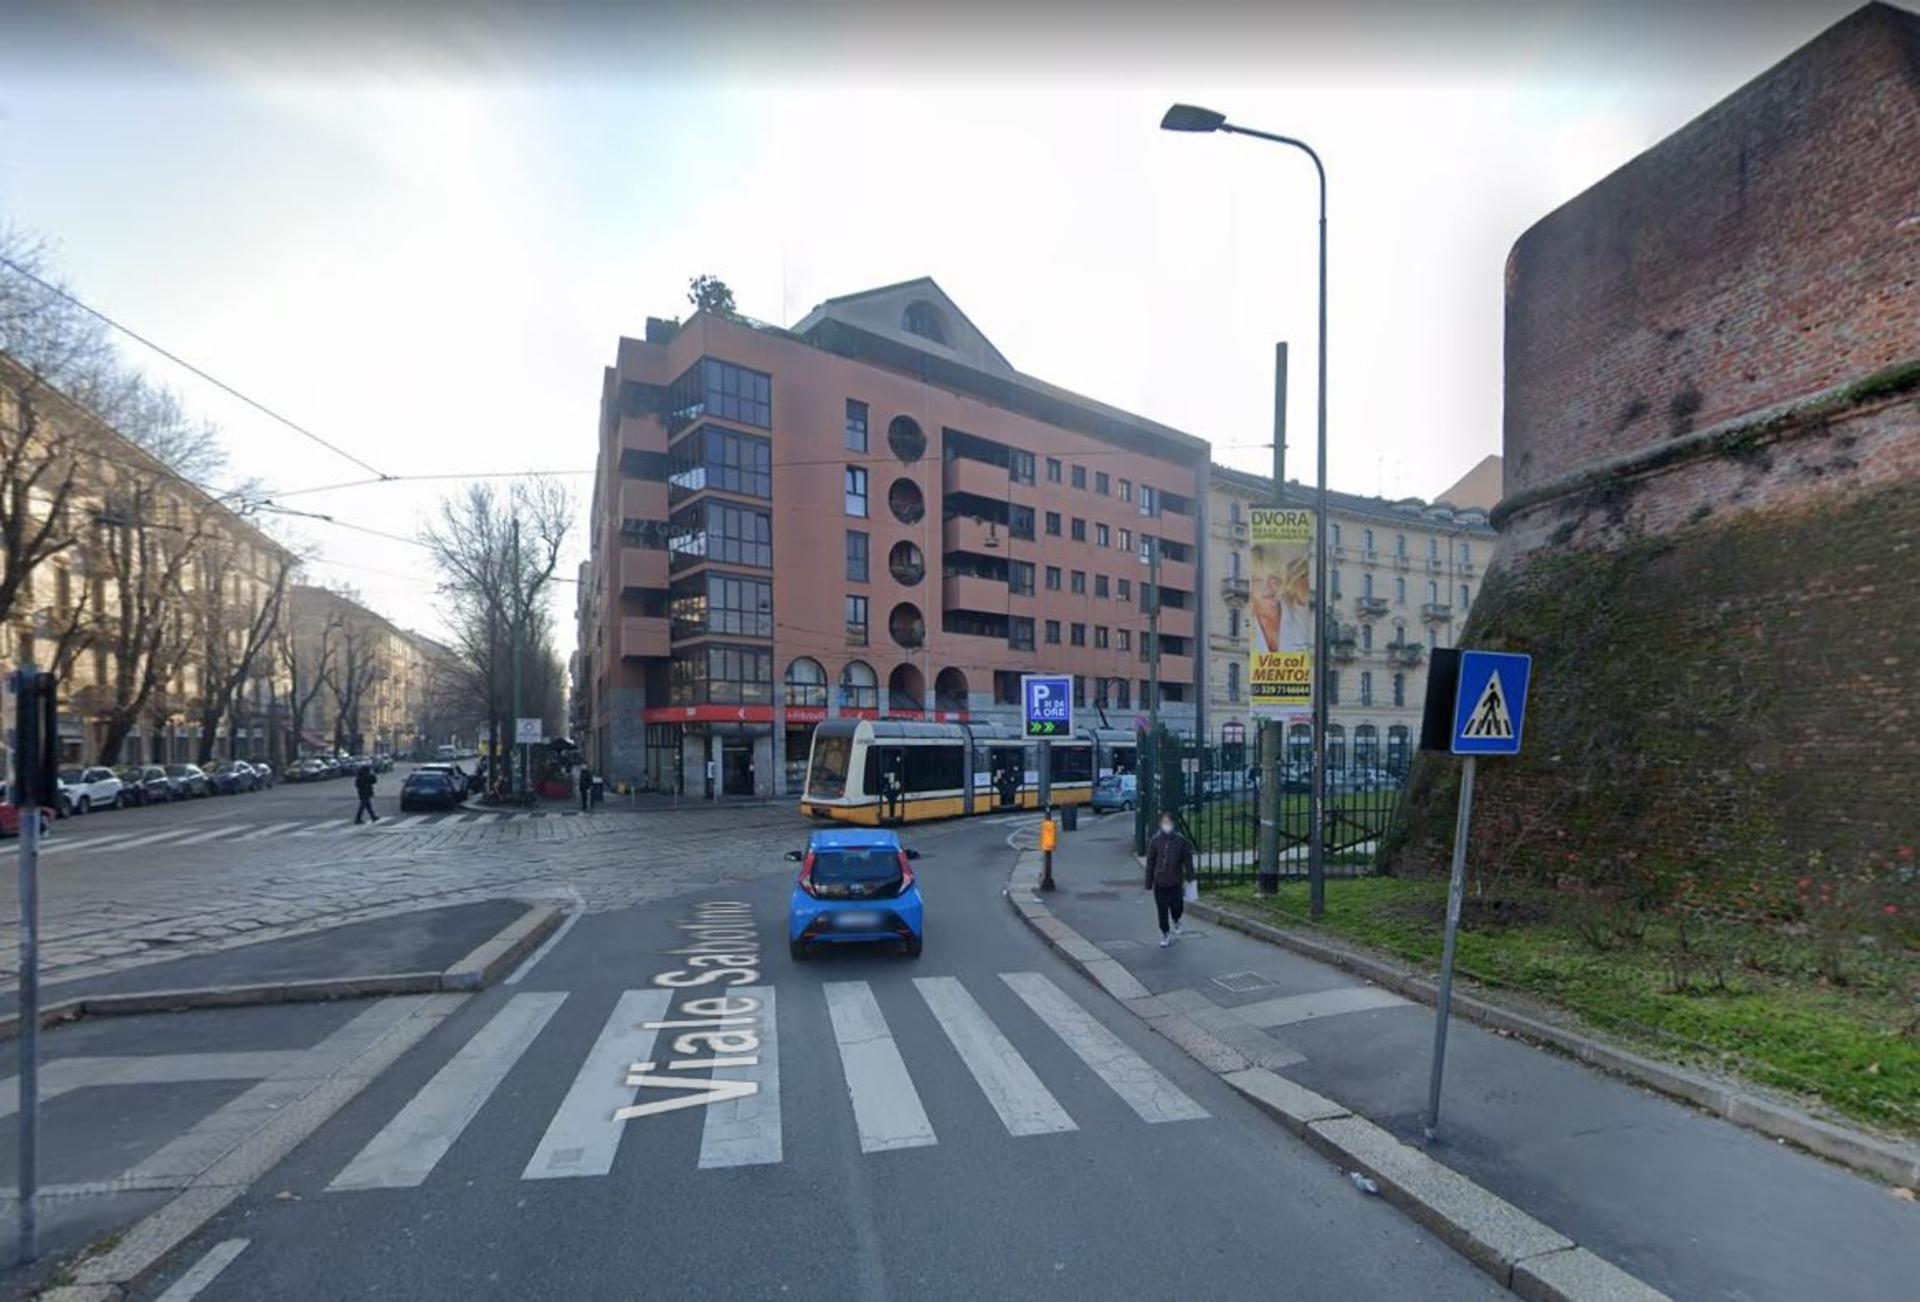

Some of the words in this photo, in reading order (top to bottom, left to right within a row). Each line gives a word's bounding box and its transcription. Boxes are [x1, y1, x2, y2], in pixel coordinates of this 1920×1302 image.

[1252, 511, 1309, 526] DVORA
[1258, 654, 1281, 667] Via
[1284, 654, 1305, 667] col
[1253, 668, 1310, 681] MENTO!
[1033, 685, 1050, 708] P
[1033, 708, 1042, 717] A
[1043, 708, 1065, 717] ORE
